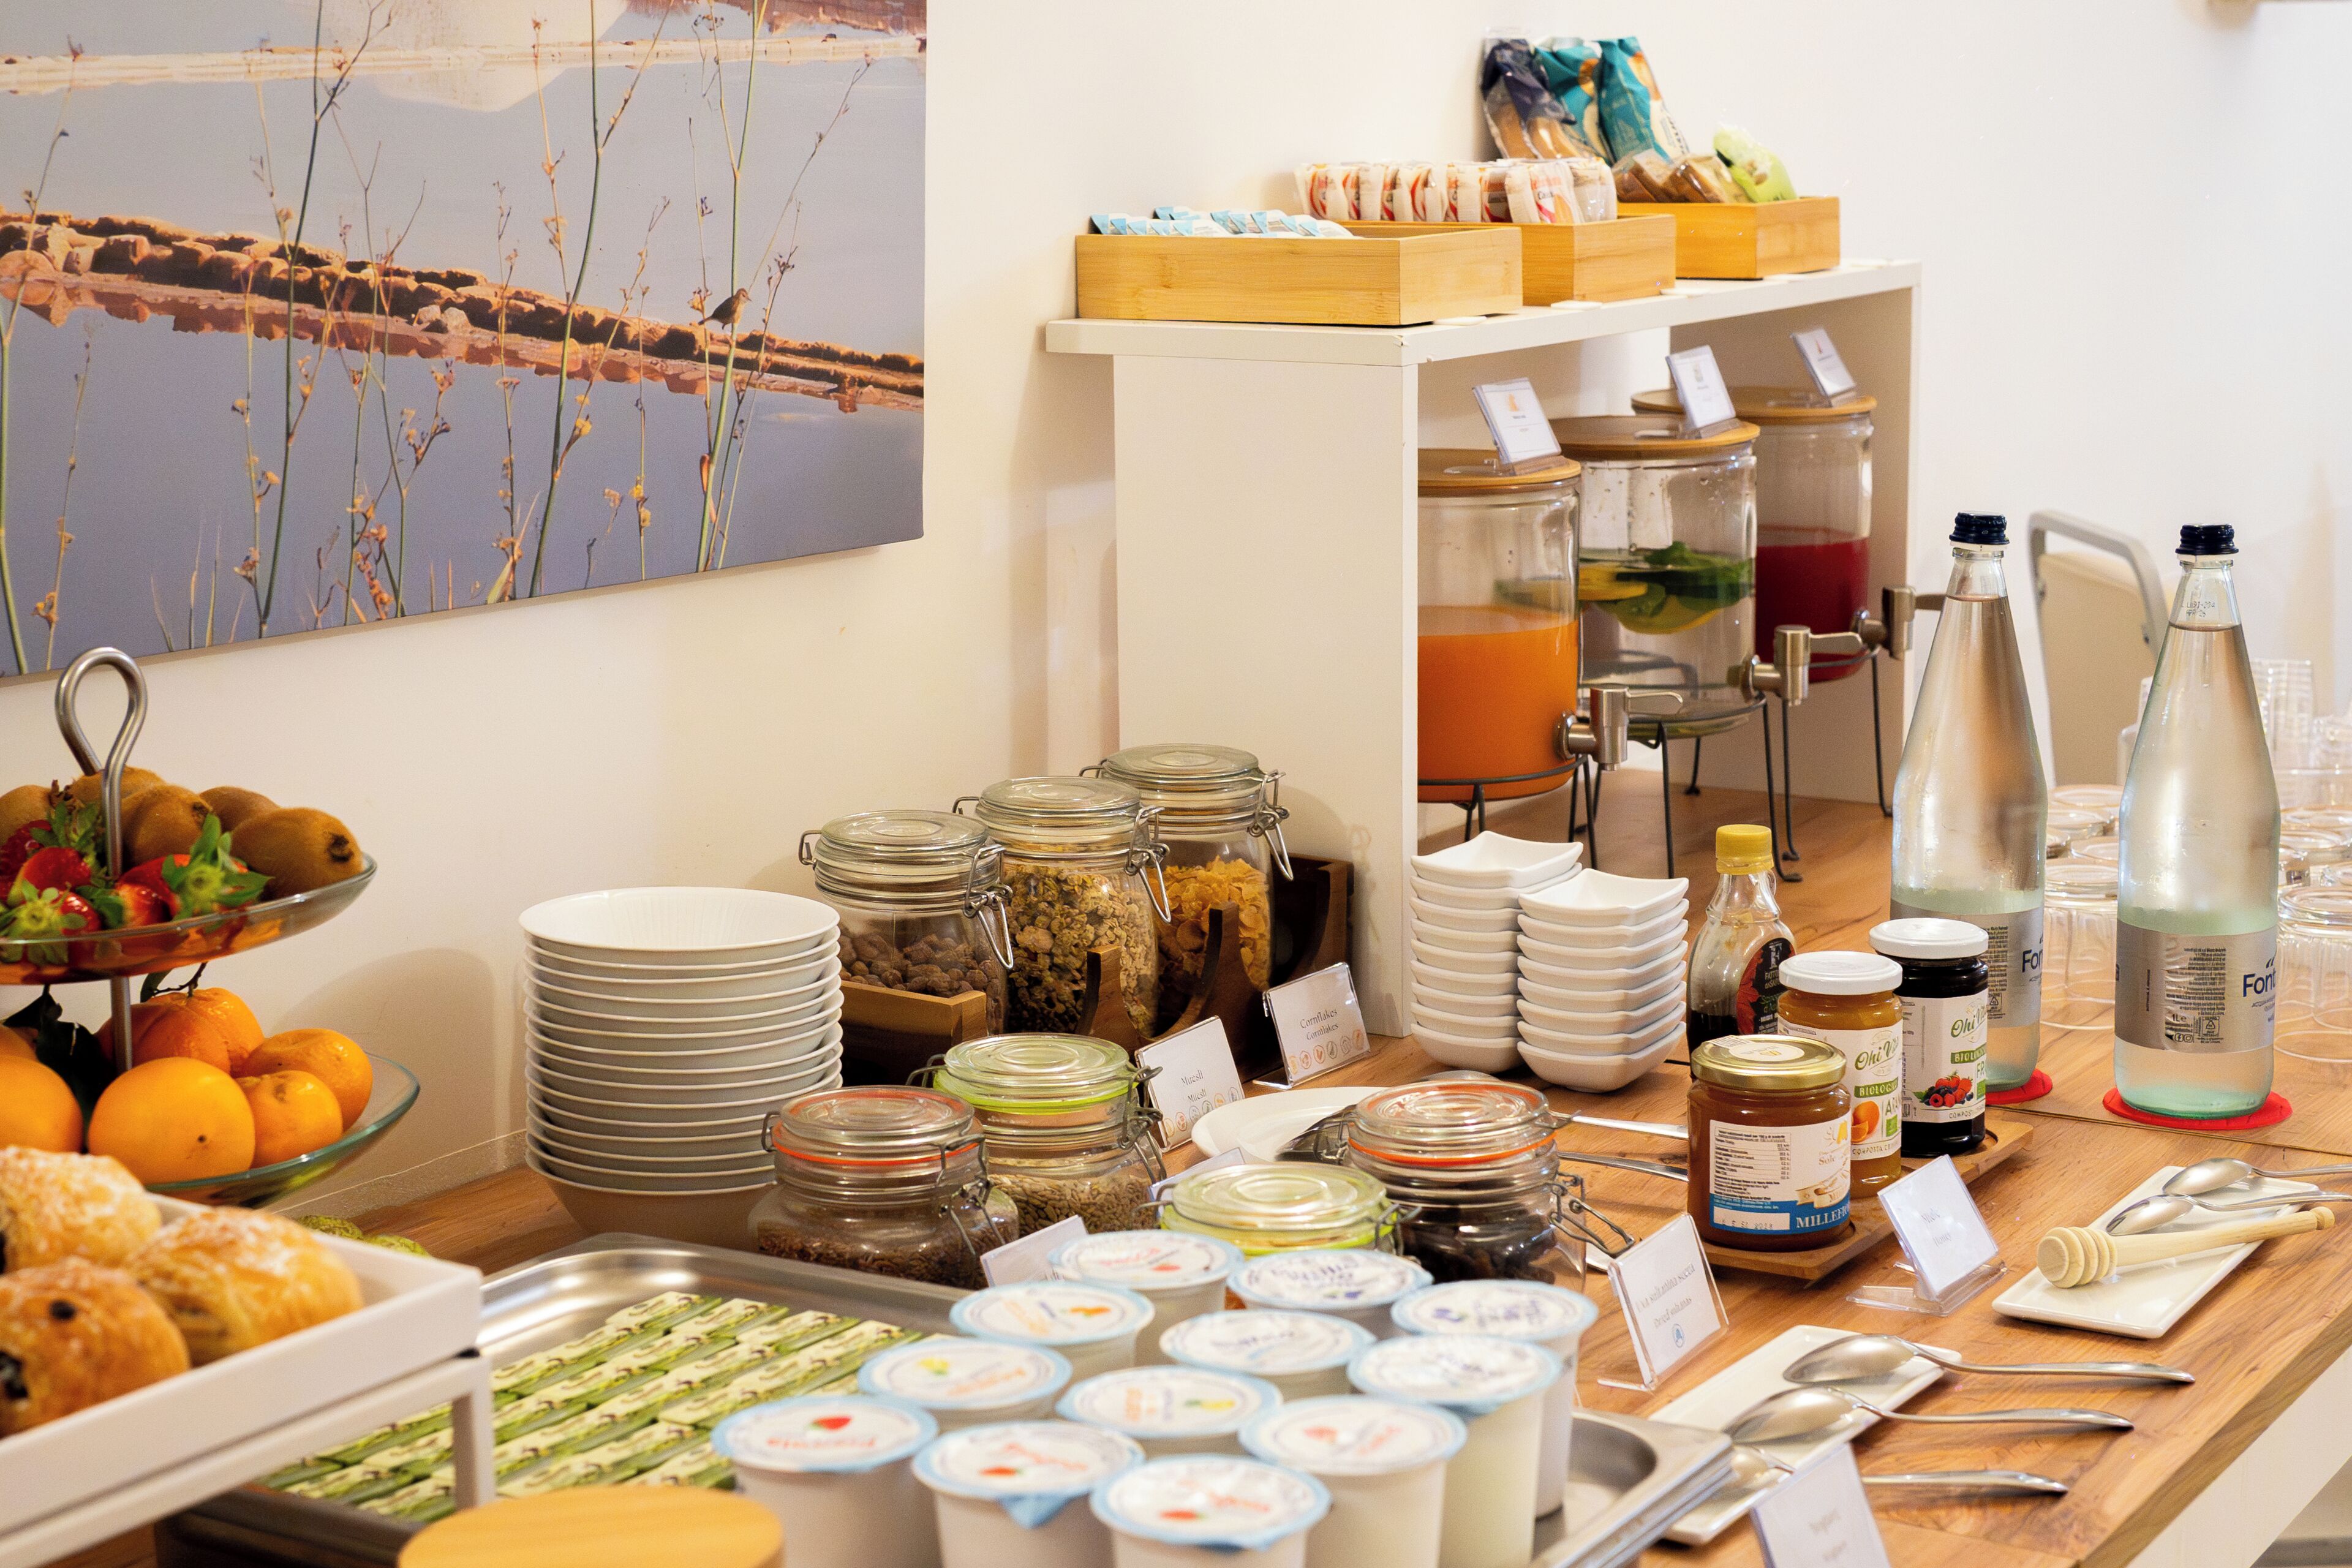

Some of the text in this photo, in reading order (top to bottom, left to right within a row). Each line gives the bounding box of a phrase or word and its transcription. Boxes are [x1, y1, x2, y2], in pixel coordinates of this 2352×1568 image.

[1300, 1009, 1338, 1028] Cornflakes
[1306, 1023, 1339, 1040] Cornflakes
[1180, 1069, 1204, 1087] Muesli
